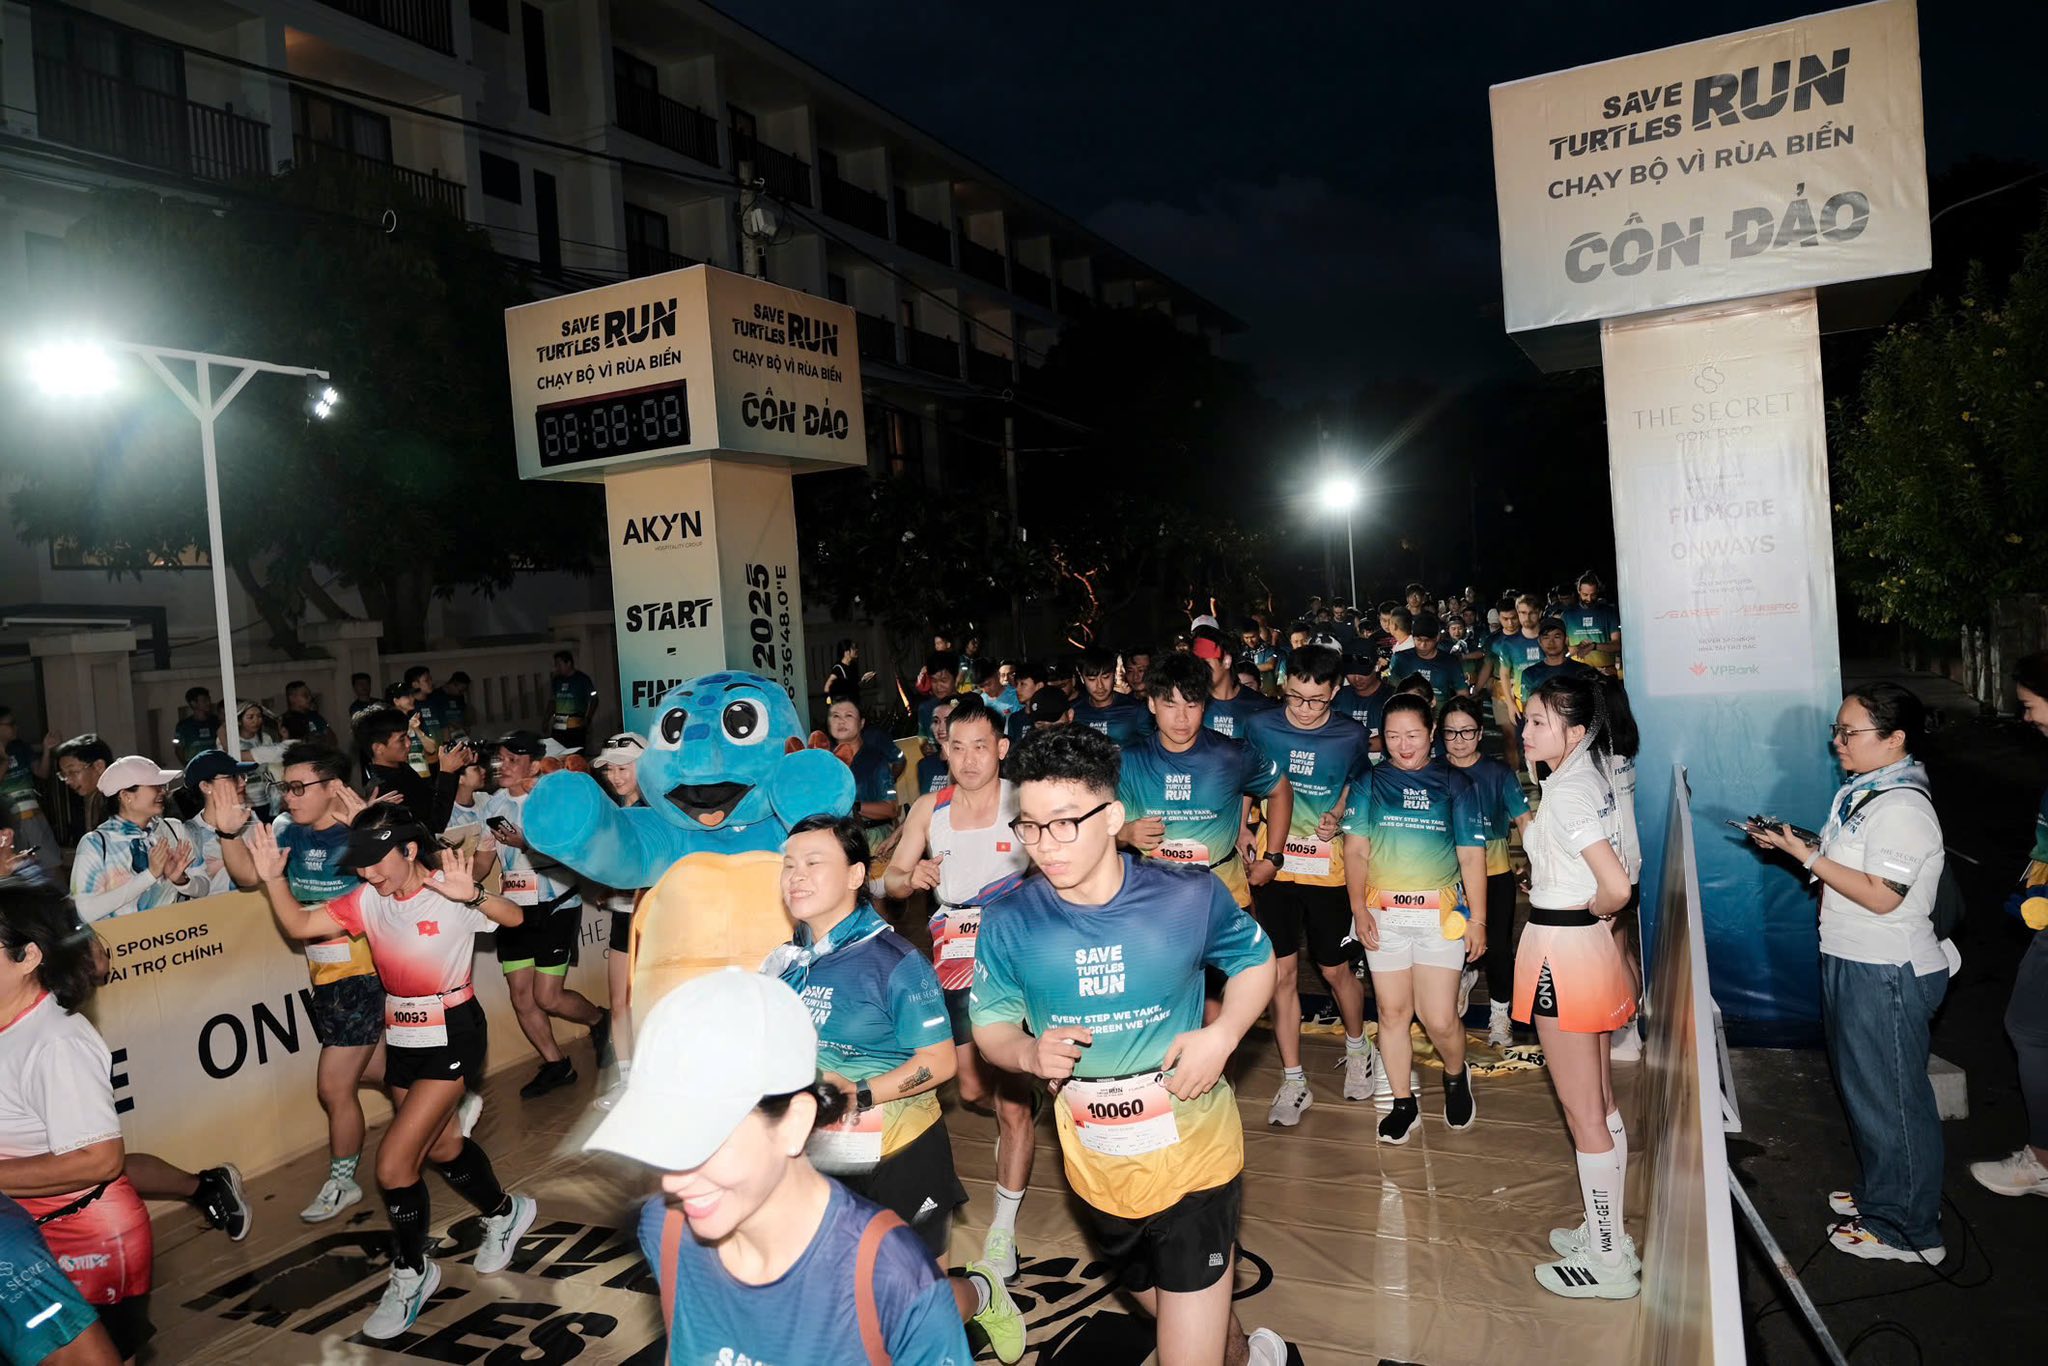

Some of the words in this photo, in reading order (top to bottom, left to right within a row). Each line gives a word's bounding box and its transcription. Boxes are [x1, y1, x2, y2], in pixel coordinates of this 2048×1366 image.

[1602, 81, 1683, 120] SAVE
[1692, 47, 1851, 132] RUN
[1549, 113, 1682, 161] TURTLES
[1548, 168, 1624, 200] CHẠY
[1630, 156, 1668, 185] BỘ
[1677, 147, 1705, 174] VÌ
[1714, 139, 1777, 168] RÙA
[1786, 120, 1855, 156] BIỂN
[1564, 211, 1705, 284] CÔN
[1724, 182, 1870, 261] ĐẢO
[561, 314, 600, 338] SAVE
[604, 297, 678, 349] RUN
[753, 303, 785, 325] SAVE
[732, 318, 786, 346] TURTLES
[788, 312, 839, 358] RUN
[536, 336, 600, 364] TURTLES
[537, 371, 572, 391] CHẠY
[576, 364, 596, 386] BỘ
[598, 357, 613, 379] VÌ
[616, 352, 646, 376] RÙA
[732, 349, 762, 369] CHẠY
[765, 355, 782, 375] BỘ
[784, 356, 796, 374] VÌ
[797, 358, 819, 379] RÙA
[741, 387, 796, 434] CÔN
[803, 398, 849, 440] ĐẢO
[1633, 406, 1684, 430] THE
[1692, 392, 1794, 425] SECRET
[1669, 499, 1776, 525] FILMORE
[622, 510, 702, 546] AKYN
[1671, 535, 1776, 560] ONWAYS
[625, 598, 713, 633] START
[745, 563, 776, 670] 2025
[1710, 664, 1761, 676] VPBank
[631, 678, 693, 708] FIN
[1213, 716, 1234, 724] SAVE
[1289, 750, 1316, 760] SAVE
[1165, 774, 1192, 784] SAVE
[1288, 765, 1314, 776] RUN
[1165, 790, 1192, 800] RUN
[1403, 800, 1430, 810] RUN
[1160, 848, 1193, 859] 10083
[1286, 842, 1317, 855] 10059
[1393, 894, 1425, 905] 10010
[116, 923, 209, 957] SPONSORS
[580, 918, 606, 947] HE
[131, 955, 167, 976] TRỢ
[171, 942, 224, 966] CHÍNH
[1075, 945, 1123, 965] SAVE
[1076, 962, 1125, 974] TURTLES
[1079, 973, 1126, 997] RUN
[1538, 962, 1553, 1009] ONW
[393, 1011, 428, 1024] 10093
[809, 1007, 832, 1025] UN
[1051, 1014, 1082, 1024] EVERY
[1084, 1013, 1110, 1024] STEP
[1113, 1011, 1131, 1021] WE
[1133, 1004, 1163, 1018] TAKE,
[1125, 1020, 1144, 1030] WE
[1087, 1098, 1144, 1119] 10060
